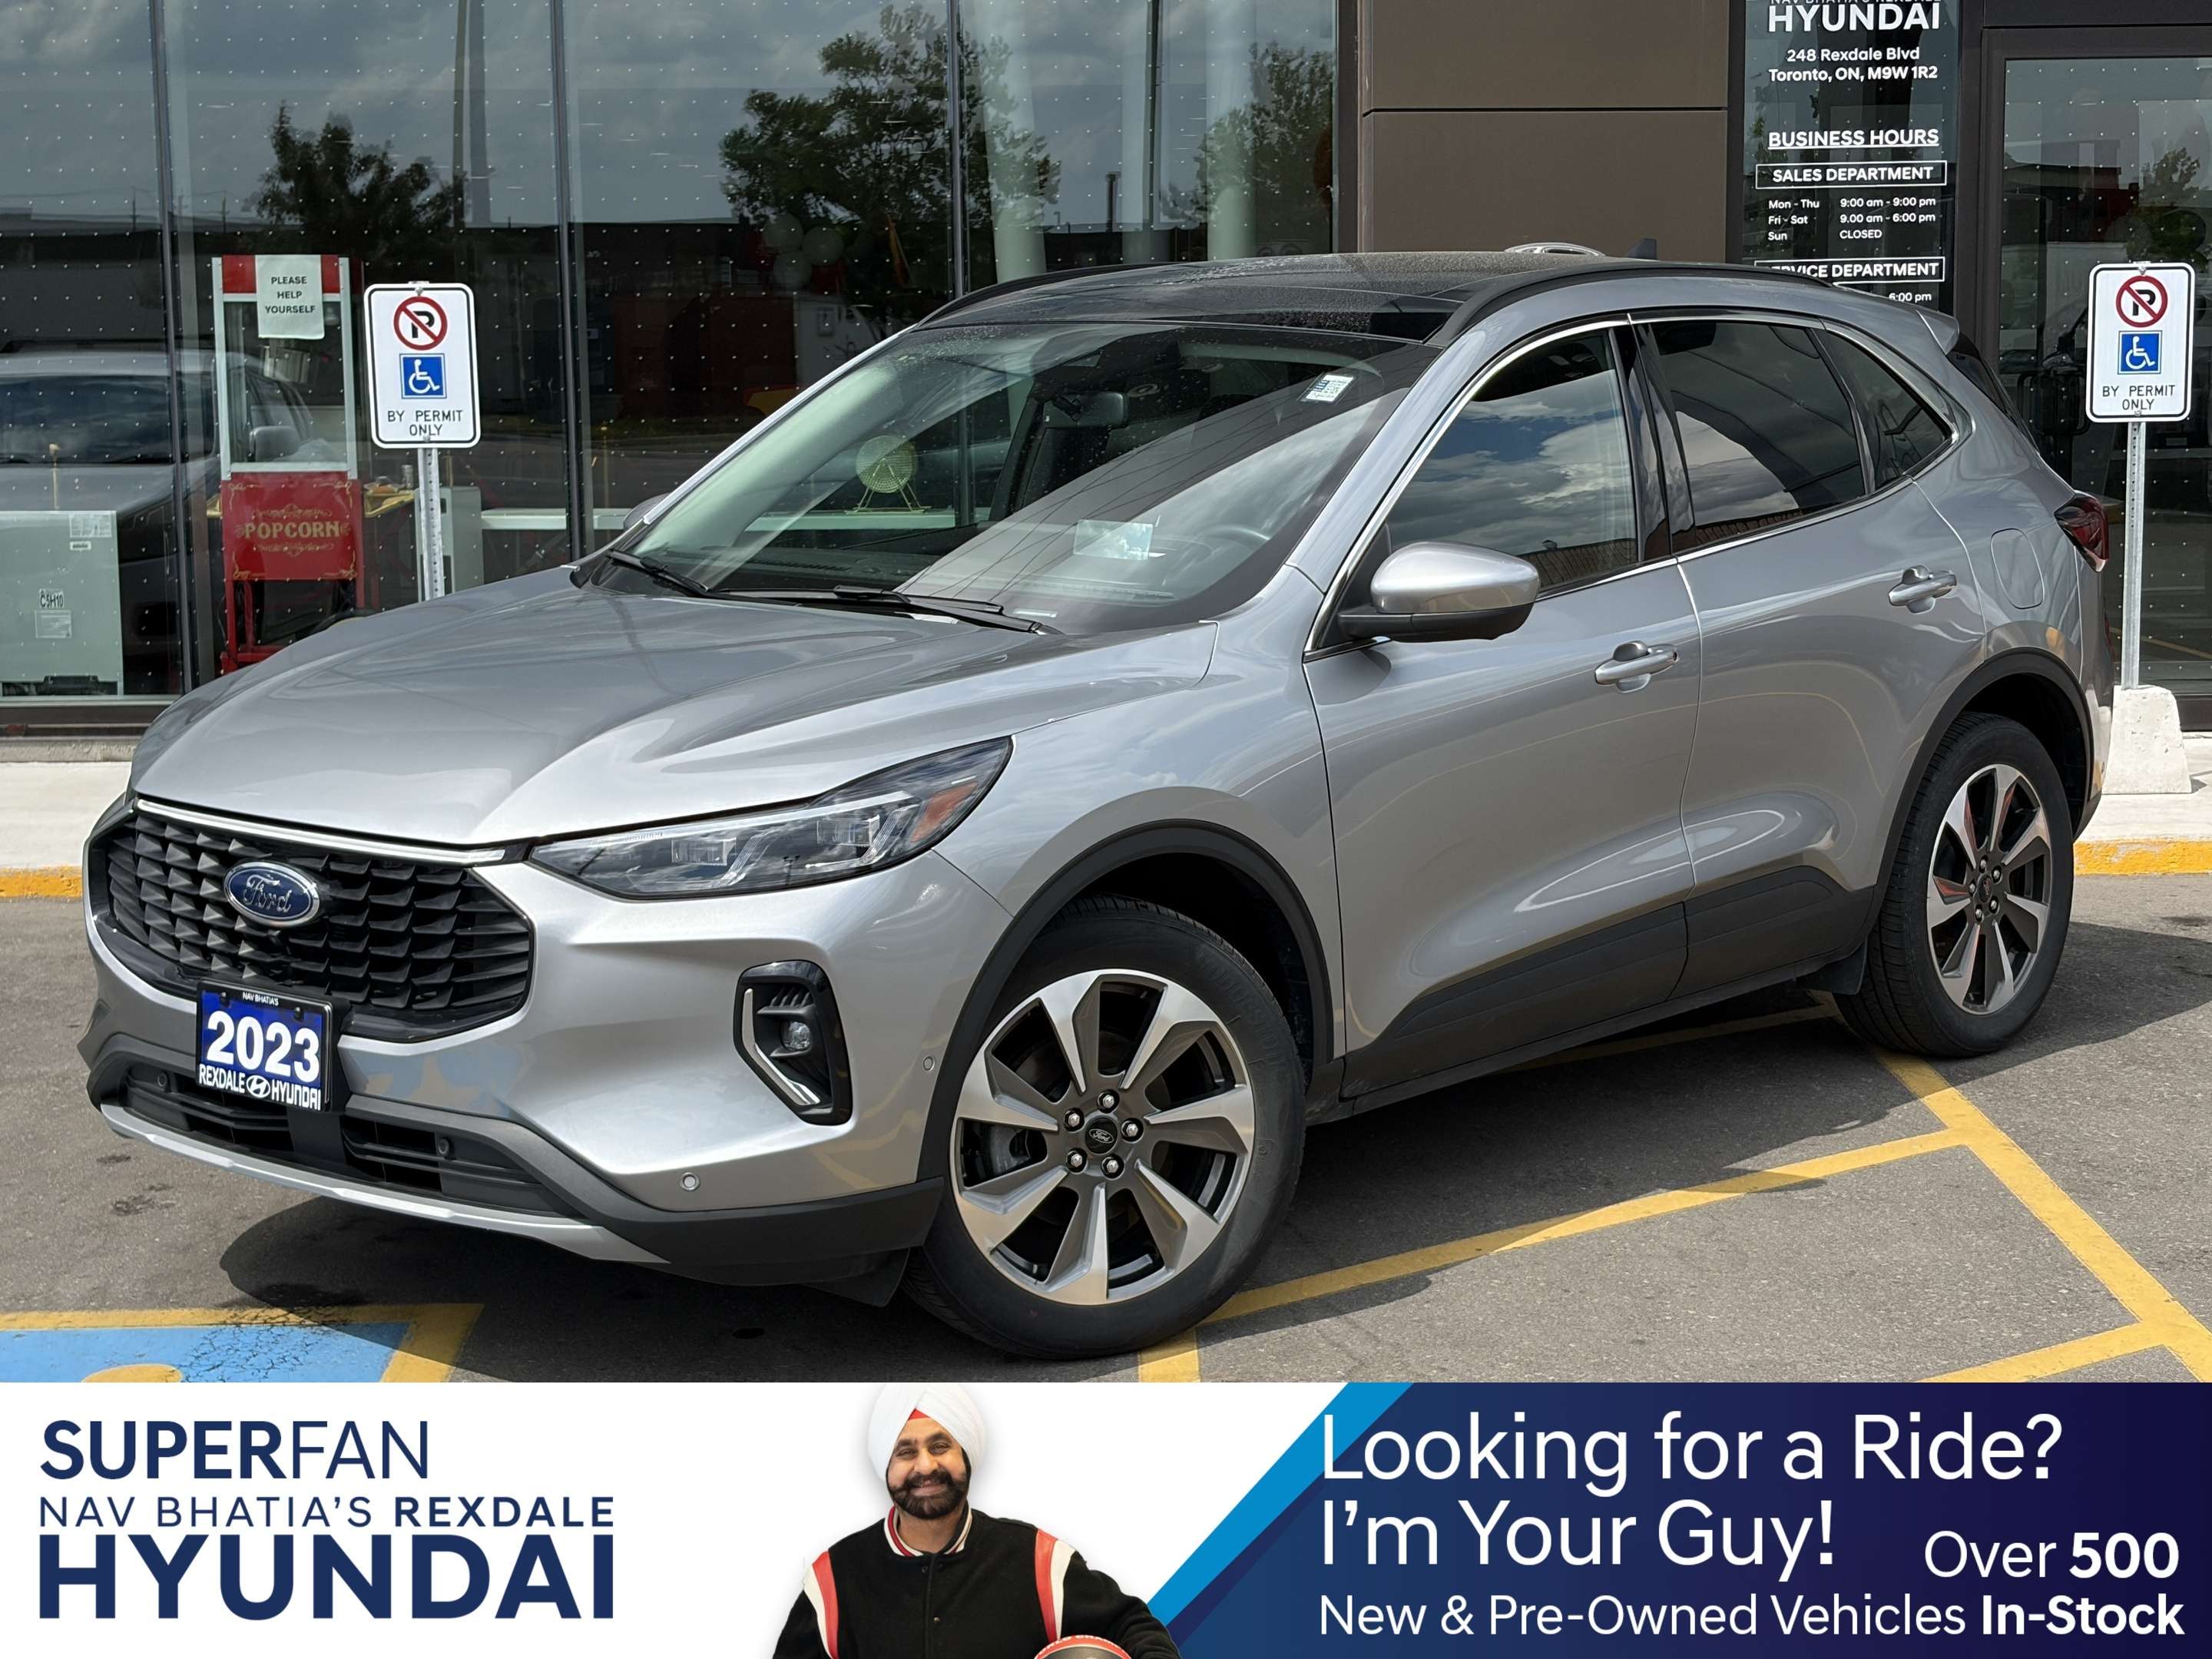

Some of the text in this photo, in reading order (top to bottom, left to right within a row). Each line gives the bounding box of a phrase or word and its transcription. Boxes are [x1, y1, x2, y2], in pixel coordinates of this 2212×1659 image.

[1769, 2, 1939, 31] HYUNDAI
[1786, 47, 1919, 61] 248 Rexdale Blvd
[1769, 65, 1938, 82] Toronto, ON, M9W 1R2
[1769, 128, 1939, 147] BUSINESS HOURS
[1773, 167, 1934, 182] SALES DEPARTMENT
[1769, 200, 1791, 209] Mon
[1800, 199, 1820, 208] Thu
[1840, 198, 1863, 207] 9:00
[1892, 197, 1916, 207] 9:00
[1919, 198, 1936, 208] pm
[1769, 216, 1781, 224] Fri
[1790, 216, 1808, 224] Sat
[1892, 213, 1916, 222] 6:00
[1919, 214, 1936, 224] pm
[1768, 230, 1883, 240] Sun CLOSED
[1832, 263, 1939, 277] DEPARTMENT
[271, 276, 307, 284] PLEASE
[1915, 293, 1932, 303] pm
[265, 305, 316, 313] YOURSELF
[2102, 385, 2176, 397] BY PERMIT
[2122, 399, 2155, 410] ONLY
[387, 409, 463, 422] BY PERMIT
[409, 424, 442, 436] ONLY
[245, 521, 340, 539] POPCORN
[243, 874, 292, 913] Ford
[242, 991, 254, 1001] NAV
[207, 1010, 320, 1083] 2023
[199, 1063, 321, 1111] REXDALE HYUNDAI
[1093, 1129, 1110, 1142] Ford
